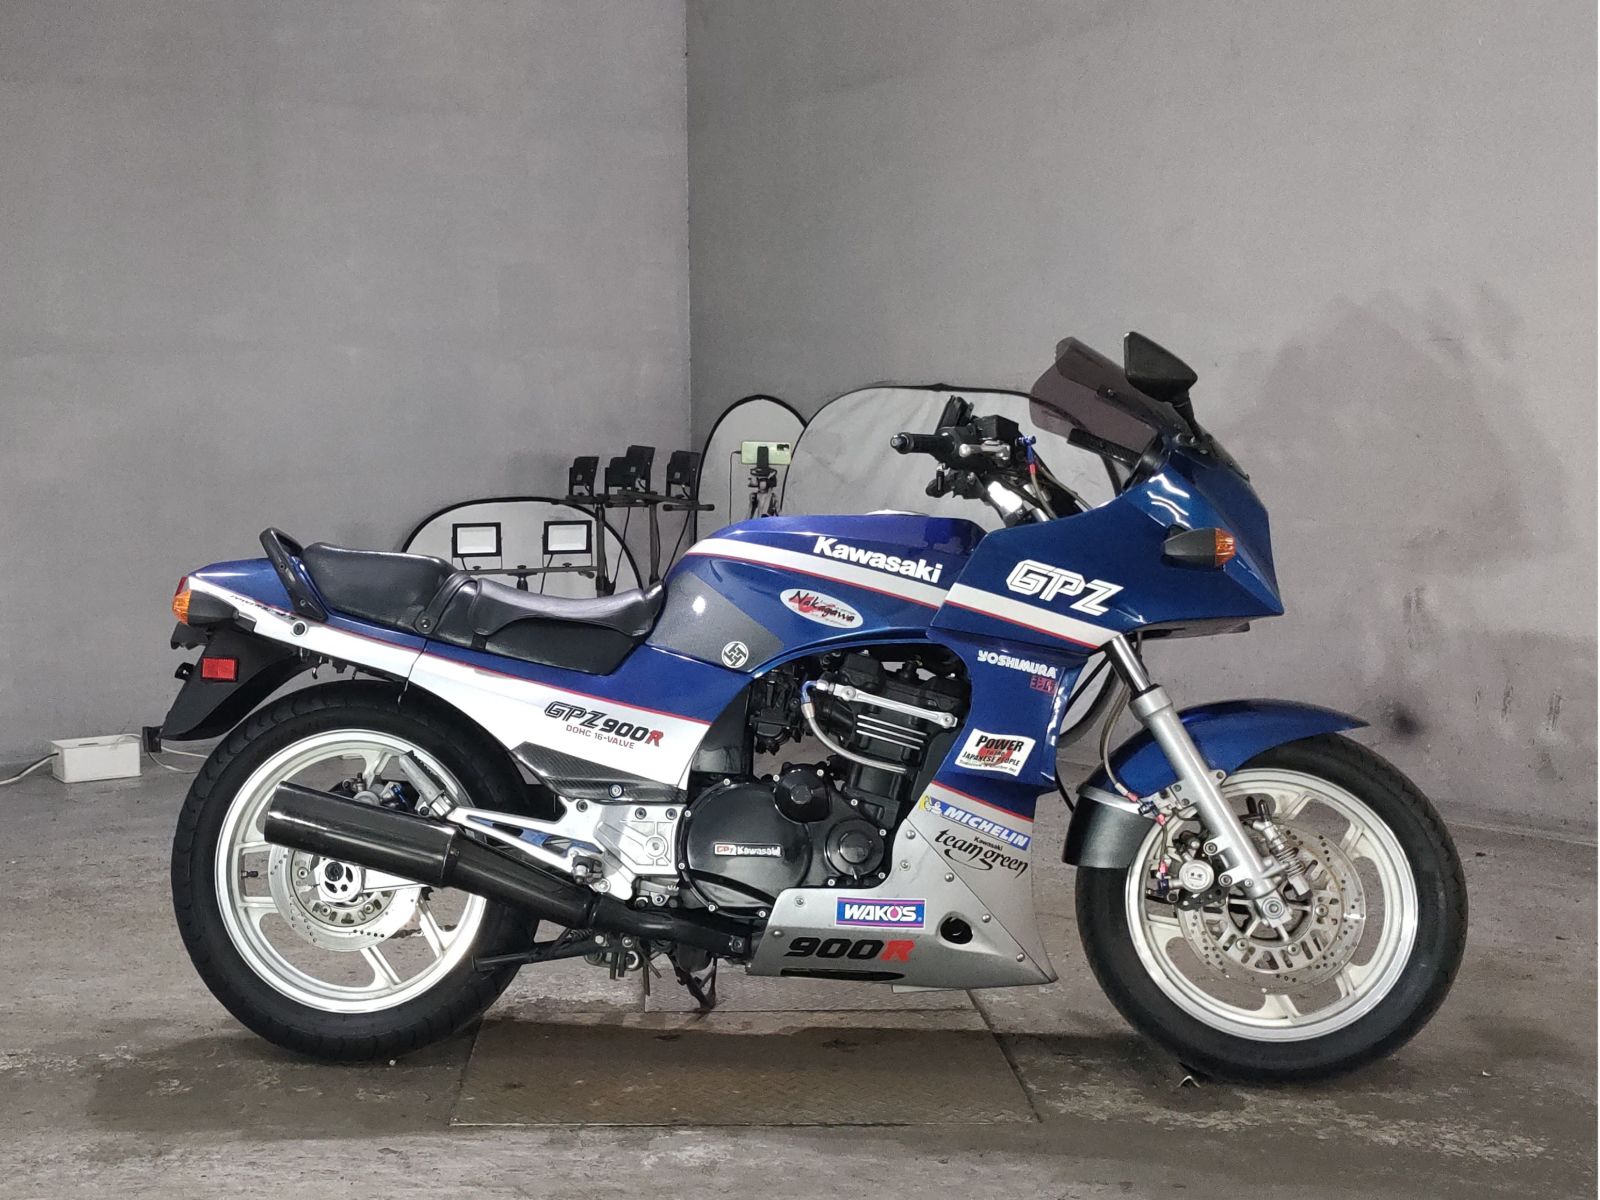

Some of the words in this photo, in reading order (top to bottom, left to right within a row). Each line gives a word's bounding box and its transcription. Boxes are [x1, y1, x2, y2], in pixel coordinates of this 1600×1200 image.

[813, 535, 943, 583] Kawasaki
[1005, 559, 1124, 616] GPZ
[788, 590, 856, 622] Nakagawa
[977, 649, 1057, 679] YOSHIMURA
[565, 724, 592, 738] DOHC
[594, 732, 635, 750] 16-VALVE
[975, 735, 1024, 752] POWER
[962, 751, 995, 763] JAPANESE
[996, 756, 1020, 767] PEOPLE
[944, 806, 1029, 847] MICHELIN
[934, 828, 984, 862] team
[966, 849, 1029, 879] green
[974, 836, 1003, 851] Kawasaki
[784, 936, 915, 962] 900R
